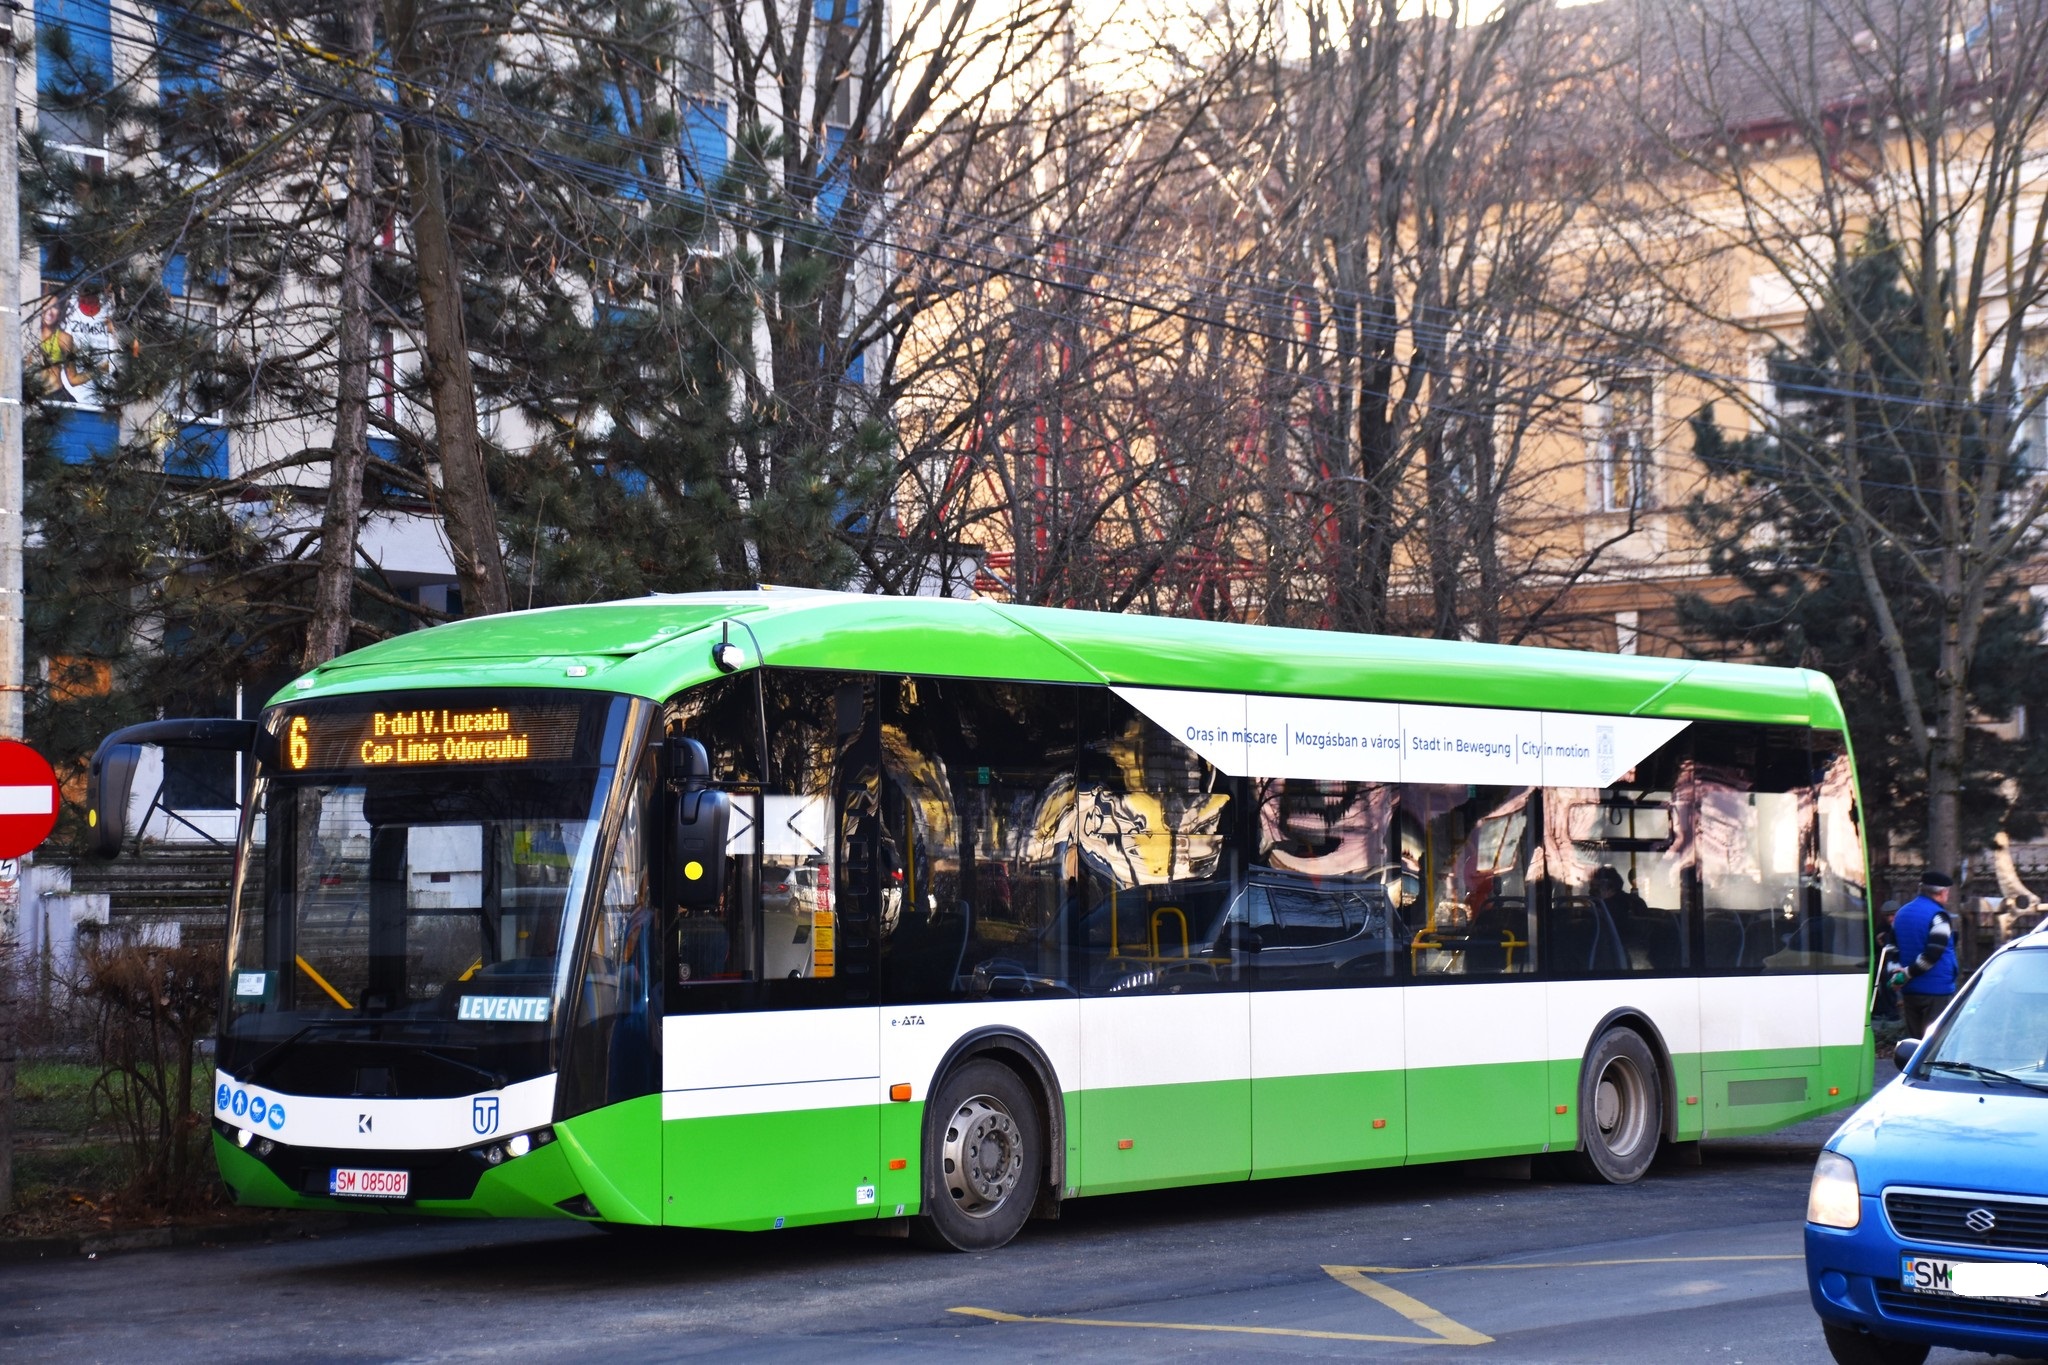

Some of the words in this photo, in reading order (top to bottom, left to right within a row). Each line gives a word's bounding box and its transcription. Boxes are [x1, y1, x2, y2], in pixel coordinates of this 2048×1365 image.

[374, 711, 418, 735] B-dul
[421, 710, 439, 734] V.
[442, 708, 509, 733] Lucaciu
[289, 716, 308, 769] 6
[1186, 726, 1214, 746] Oraș
[1217, 727, 1229, 742] în
[1295, 731, 1358, 749] Mozgásban
[1361, 736, 1368, 748] a
[1371, 734, 1400, 750] város
[1412, 736, 1441, 751] Stadt
[1443, 738, 1453, 752] in
[1456, 739, 1511, 757] Bewegung
[361, 740, 393, 763] Cap
[397, 738, 439, 762] Linie
[442, 734, 528, 760] Odoreului
[1522, 742, 1542, 758] City
[1544, 742, 1553, 756] in
[1556, 743, 1590, 758] motion
[460, 998, 548, 1020] LEVENTE
[338, 1171, 356, 1191] SM
[361, 1172, 407, 1193] 085081
[1904, 1275, 1915, 1286] RO
[1914, 1261, 1949, 1288] SM
